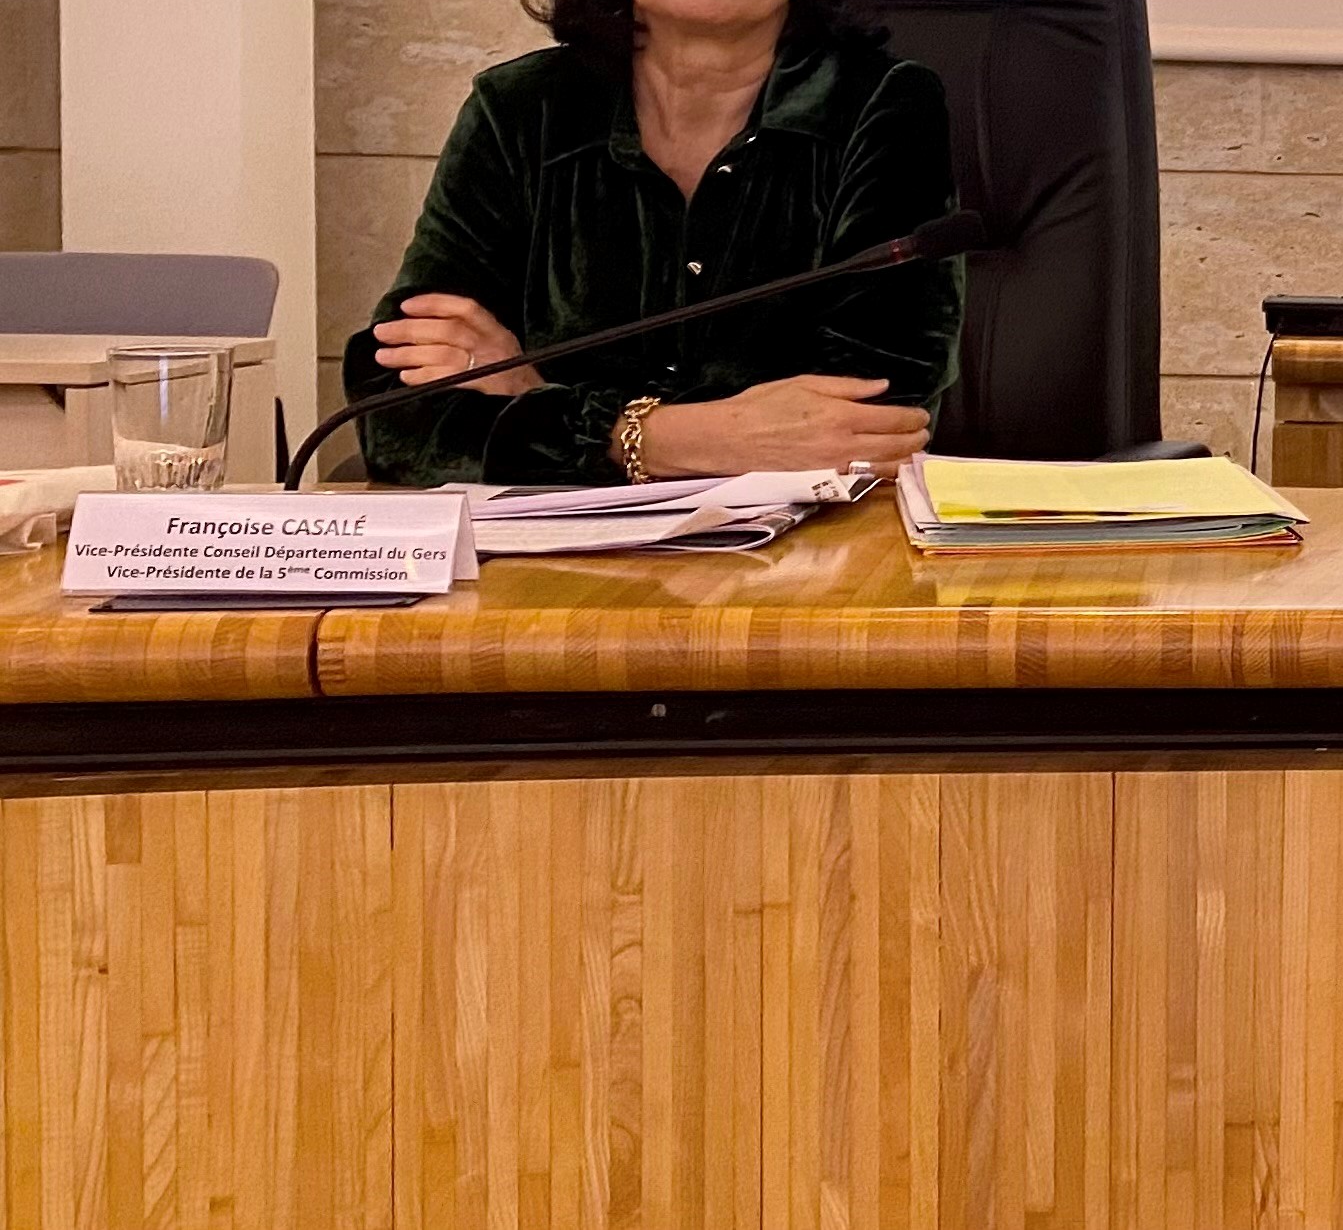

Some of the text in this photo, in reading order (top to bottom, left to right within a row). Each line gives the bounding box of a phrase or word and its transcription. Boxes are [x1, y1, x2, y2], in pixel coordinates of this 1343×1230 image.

[166, 513, 368, 540] Françoise CASALÉ
[74, 543, 448, 564] Vice-Présidente Conseil Départemental du Gers
[105, 563, 232, 581] Vice-Présidente
[234, 564, 256, 581] de
[258, 564, 274, 581] la
[312, 565, 410, 582] Commission
